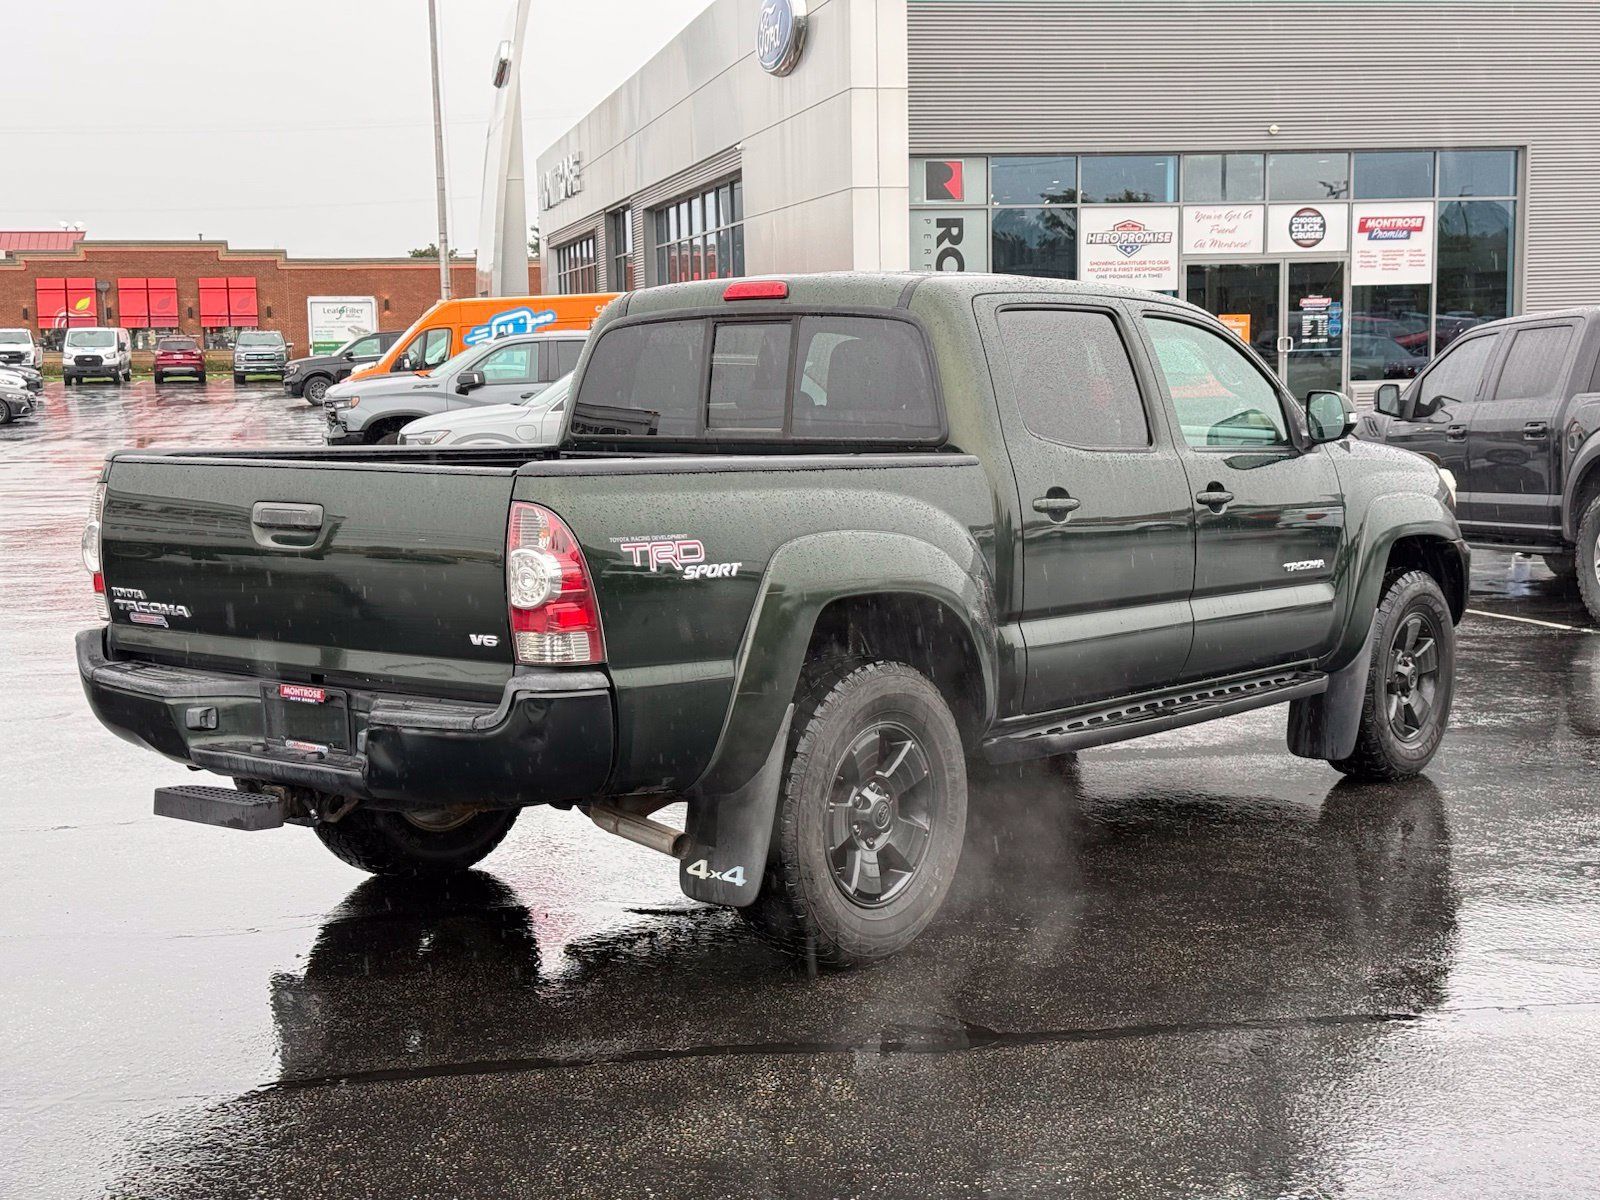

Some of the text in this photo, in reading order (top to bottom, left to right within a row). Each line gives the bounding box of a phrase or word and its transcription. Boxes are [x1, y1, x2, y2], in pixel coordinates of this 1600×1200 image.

[760, 3, 782, 58] Ford
[1194, 209, 1253, 223] You've Got A
[1365, 217, 1424, 229] MONTROSE
[1291, 224, 1324, 232] CLICK.
[1371, 228, 1409, 239] Promise
[1086, 231, 1172, 245] HERO PROMISE
[1292, 232, 1324, 240] CRUISE!
[651, 533, 688, 541] DEVELOPMENT
[620, 539, 706, 572] TRD
[683, 561, 743, 580] SPORT
[1282, 559, 1326, 572] TACOMA
[111, 586, 147, 600] TOYOTA
[114, 599, 192, 618] TACOMA
[469, 633, 499, 647] V6
[283, 686, 322, 699] MONTROSE
[686, 859, 748, 887] 4x4
